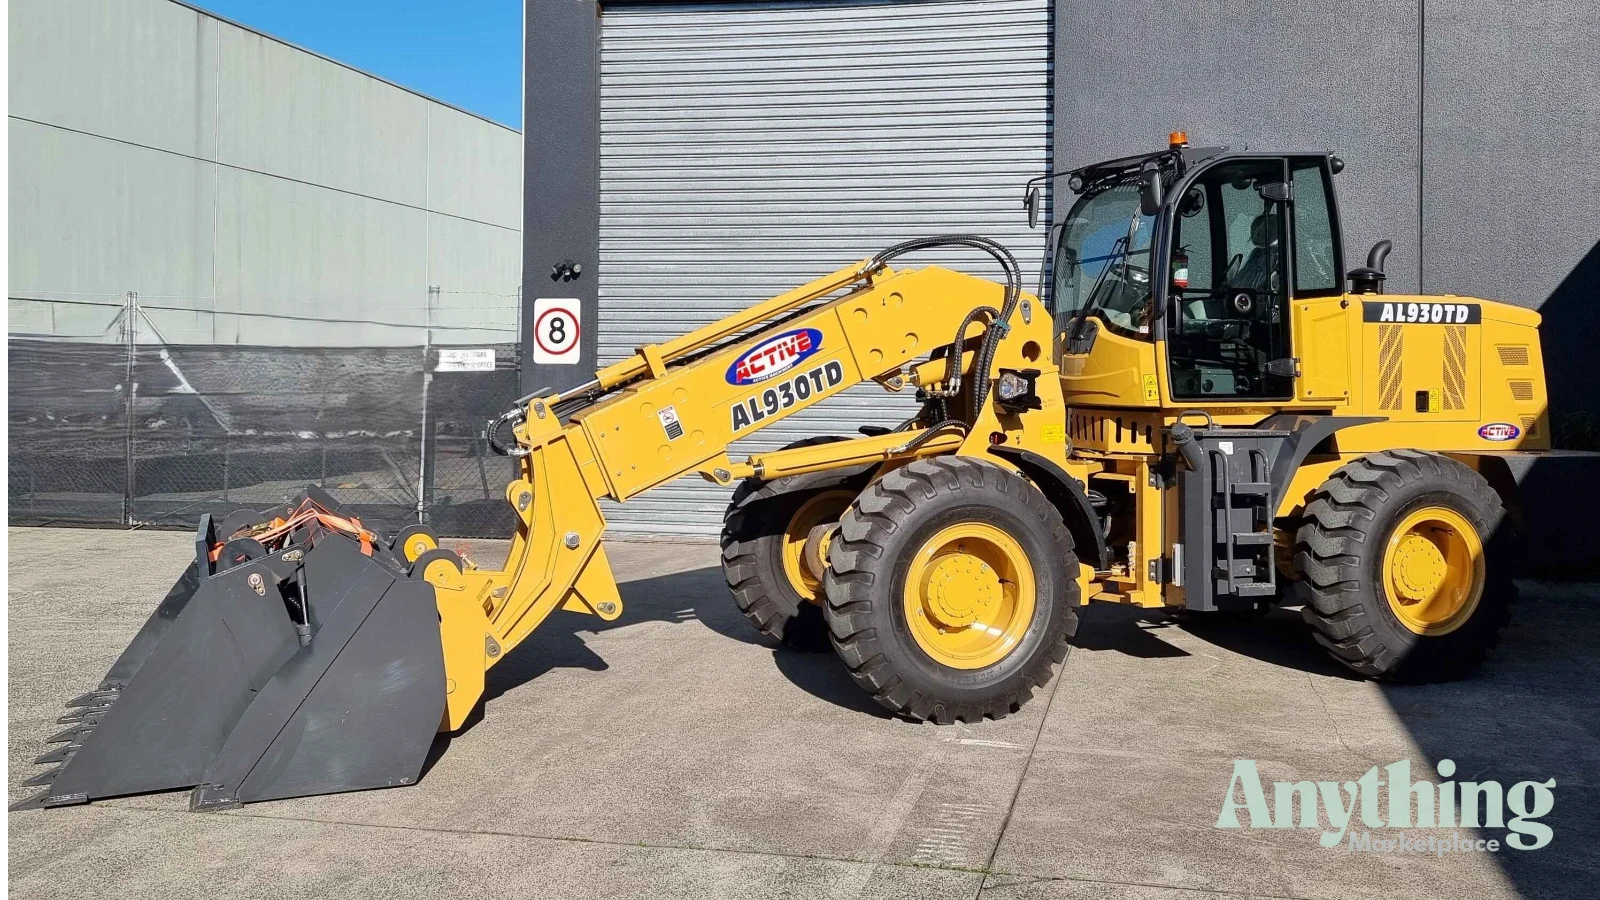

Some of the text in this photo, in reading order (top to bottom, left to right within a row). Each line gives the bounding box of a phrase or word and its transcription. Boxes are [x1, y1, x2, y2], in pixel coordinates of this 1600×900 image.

[1380, 303, 1469, 323] AL930TD
[549, 317, 565, 344] 8
[736, 331, 812, 383] ACTIVE
[732, 360, 843, 432] AL930TD
[1480, 426, 1516, 437] ACTIVE
